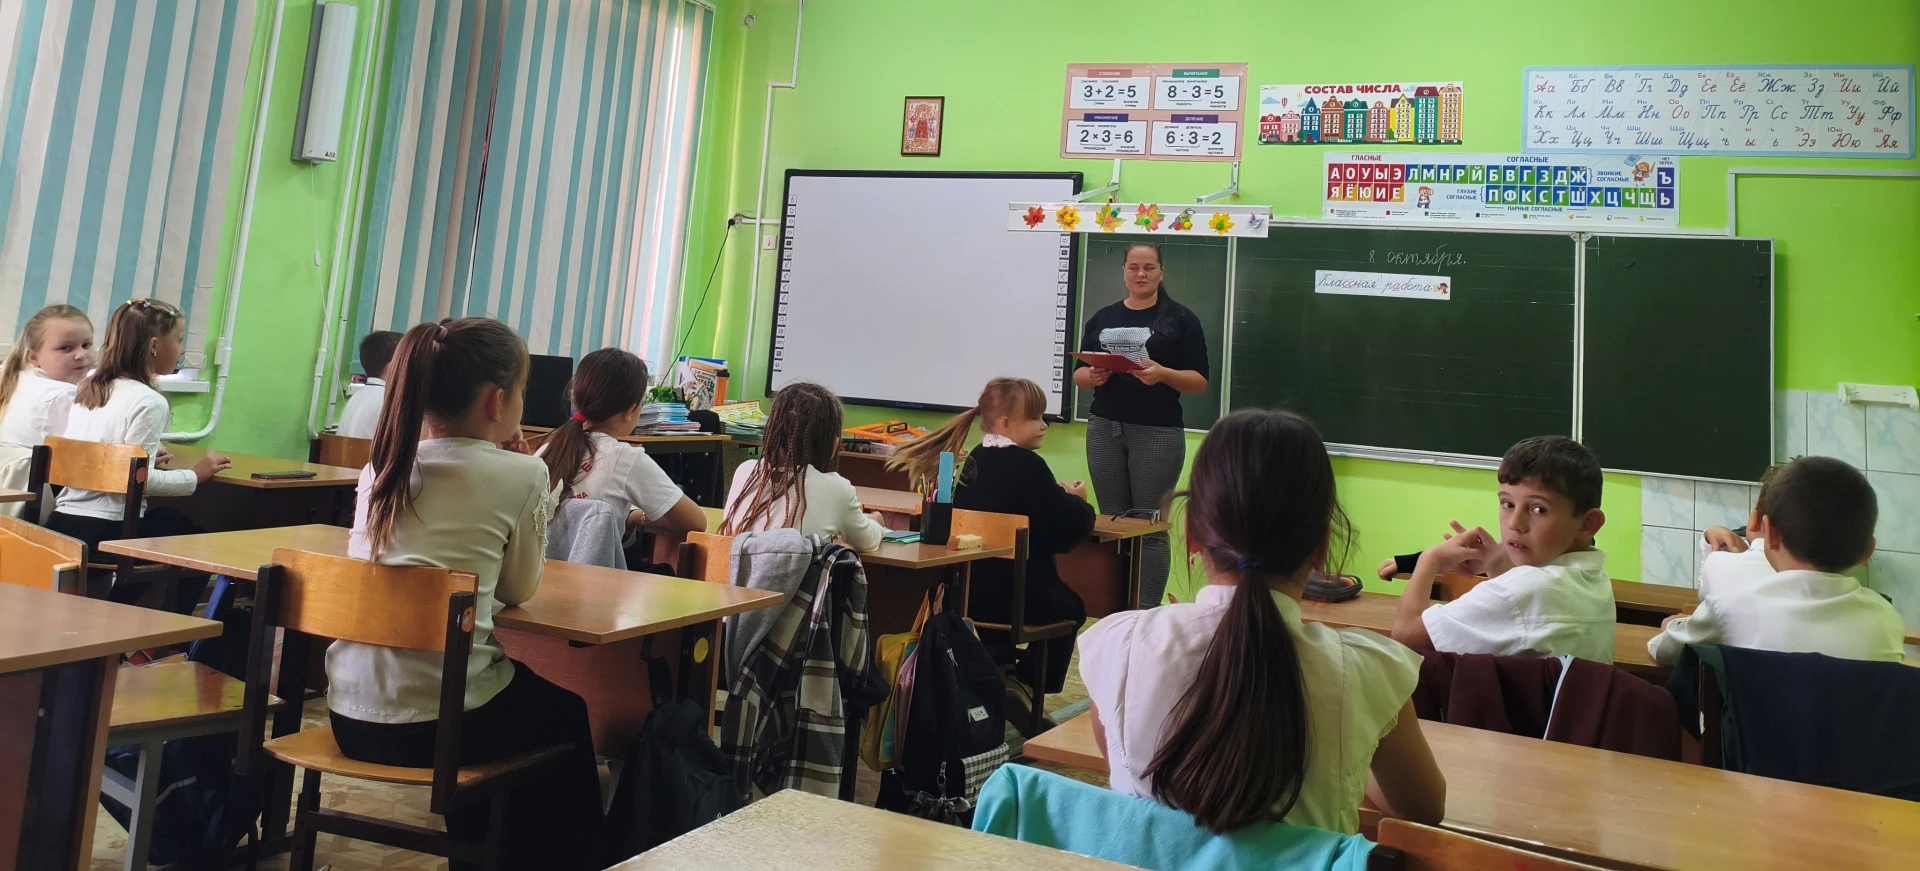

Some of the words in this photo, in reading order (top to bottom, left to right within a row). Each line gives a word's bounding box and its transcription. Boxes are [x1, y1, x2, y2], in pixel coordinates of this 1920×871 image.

[1305, 85, 1354, 94] СОСТАВ
[1357, 85, 1401, 93] ЧИСЛА
[1534, 80, 1555, 92] Аа
[1571, 79, 1595, 92] Бб
[1604, 79, 1624, 92] Вв
[1637, 79, 1653, 92] Гг
[1668, 79, 1688, 97] Дд
[1702, 79, 1716, 92] Ее
[1730, 76, 1746, 92] Ёё
[1758, 79, 1795, 92] Жж
[1808, 78, 1824, 98] Зз
[1840, 79, 1861, 92] Ии
[1877, 76, 1899, 93] Йй
[1534, 105, 1553, 119] Кк
[1564, 106, 1586, 119] Лл
[1595, 106, 1625, 119] Мм
[1637, 105, 1659, 119] Нн
[1672, 105, 1690, 119] Оо
[1702, 105, 1726, 119] Пп
[1739, 105, 1759, 124] Рр
[1771, 105, 1788, 119] Сс
[1800, 106, 1834, 120] Тт
[1847, 106, 1865, 125] Уу
[1878, 106, 1902, 126] Фф
[1534, 131, 1559, 144] Хх
[1571, 132, 1592, 147] Цц
[1605, 132, 1621, 144] Чч
[1635, 132, 1663, 145] Шш
[1678, 132, 1710, 149] Щщ
[1798, 133, 1816, 147] Ээ
[1832, 133, 1861, 147] Юю
[1876, 134, 1898, 148] Яя
[1319, 274, 1377, 288] Классная
[1382, 278, 1433, 294] работа
